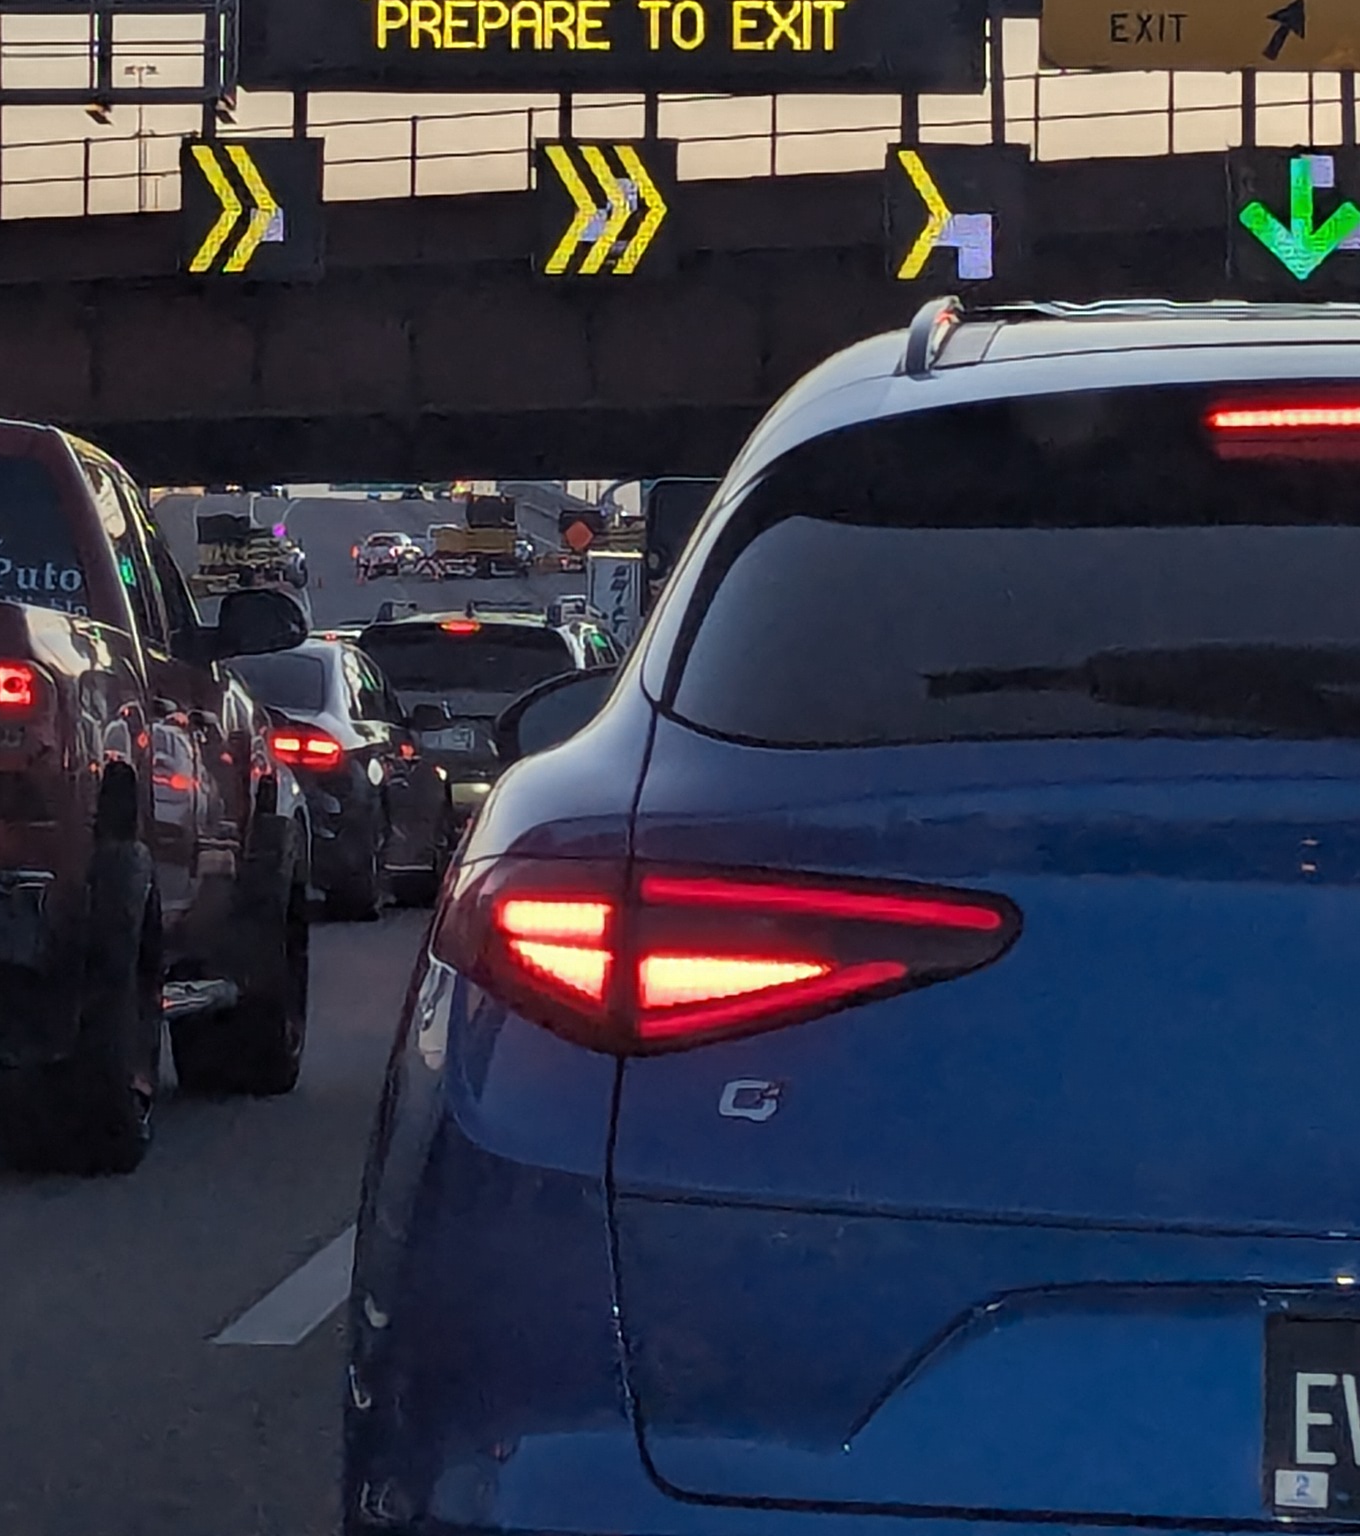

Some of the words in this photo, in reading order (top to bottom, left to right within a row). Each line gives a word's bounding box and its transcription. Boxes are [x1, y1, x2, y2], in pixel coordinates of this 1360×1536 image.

[376, 0, 612, 52] PREPARE
[638, 0, 706, 52] TO
[731, 0, 846, 52] EXIT
[1110, 12, 1189, 45] EXIT
